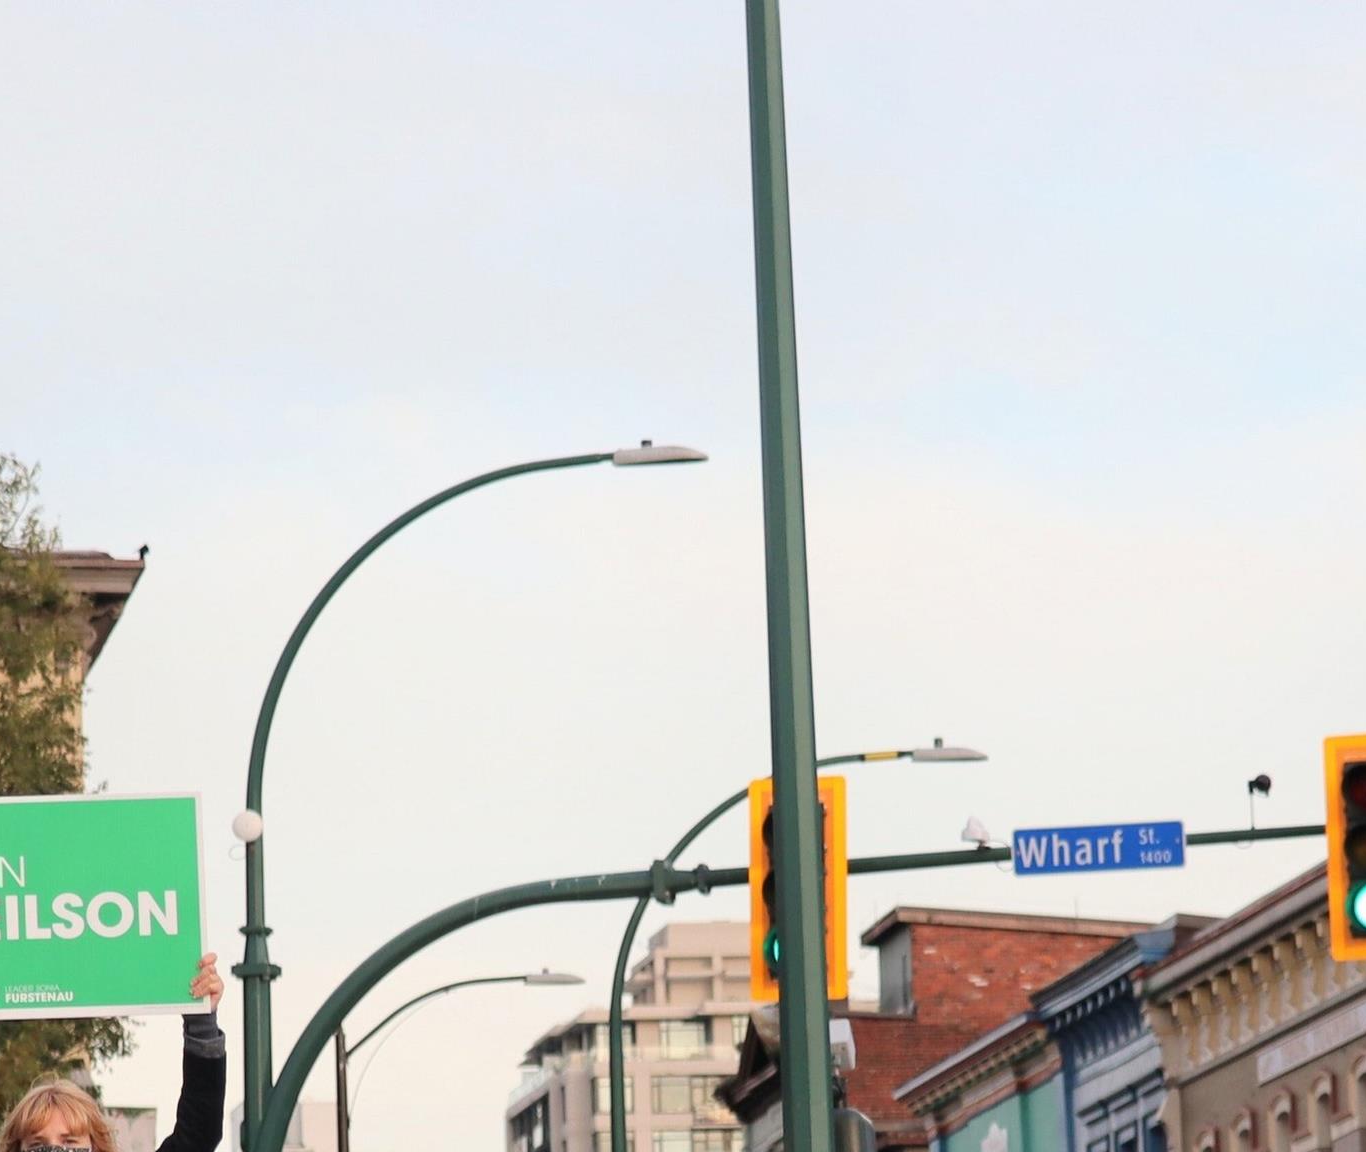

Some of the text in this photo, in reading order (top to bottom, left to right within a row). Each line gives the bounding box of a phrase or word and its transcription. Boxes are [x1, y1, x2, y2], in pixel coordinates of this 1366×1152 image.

[1017, 828, 1160, 868] Wharf St.
[1140, 851, 1172, 864] 1400
[4, 991, 74, 1004] FURSTENAU
